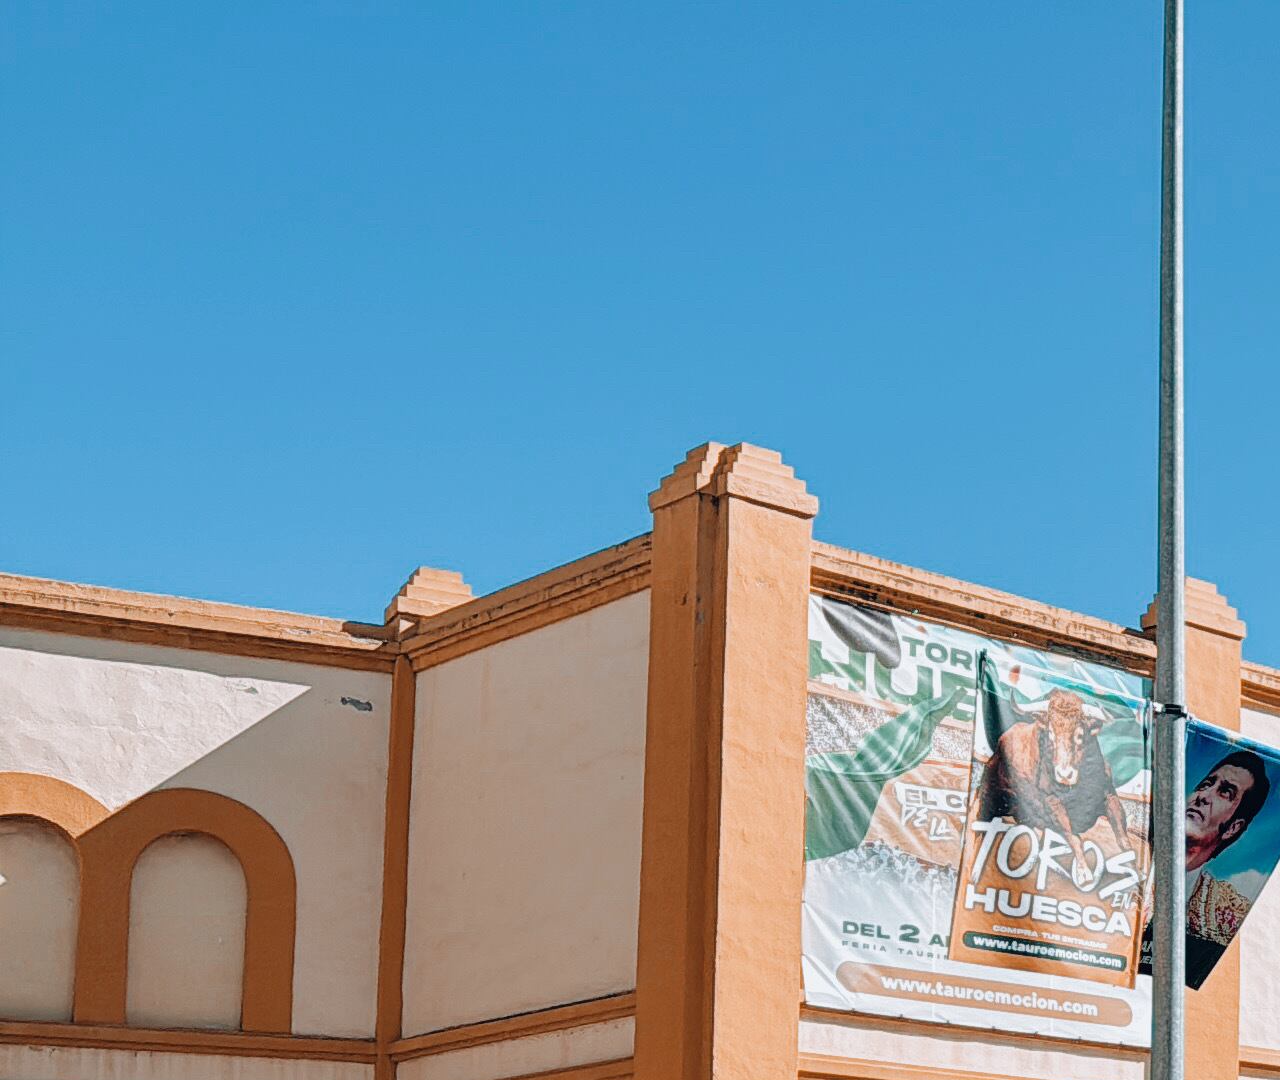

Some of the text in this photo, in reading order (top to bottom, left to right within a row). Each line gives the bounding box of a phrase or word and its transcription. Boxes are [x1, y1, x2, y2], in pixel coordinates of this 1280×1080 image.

[902, 636, 974, 670] TOR
[904, 788, 968, 810] EL C
[971, 817, 1142, 900] TOROS
[964, 883, 1132, 936] HUESCA
[1111, 890, 1133, 911] EN
[841, 940, 887, 953] FERIA
[842, 920, 950, 949] DEL 2 A
[991, 924, 1039, 939] COMPRA
[973, 934, 1122, 968] www.tauroemocion.com
[881, 974, 1098, 1017] www.tauroemocion.com
